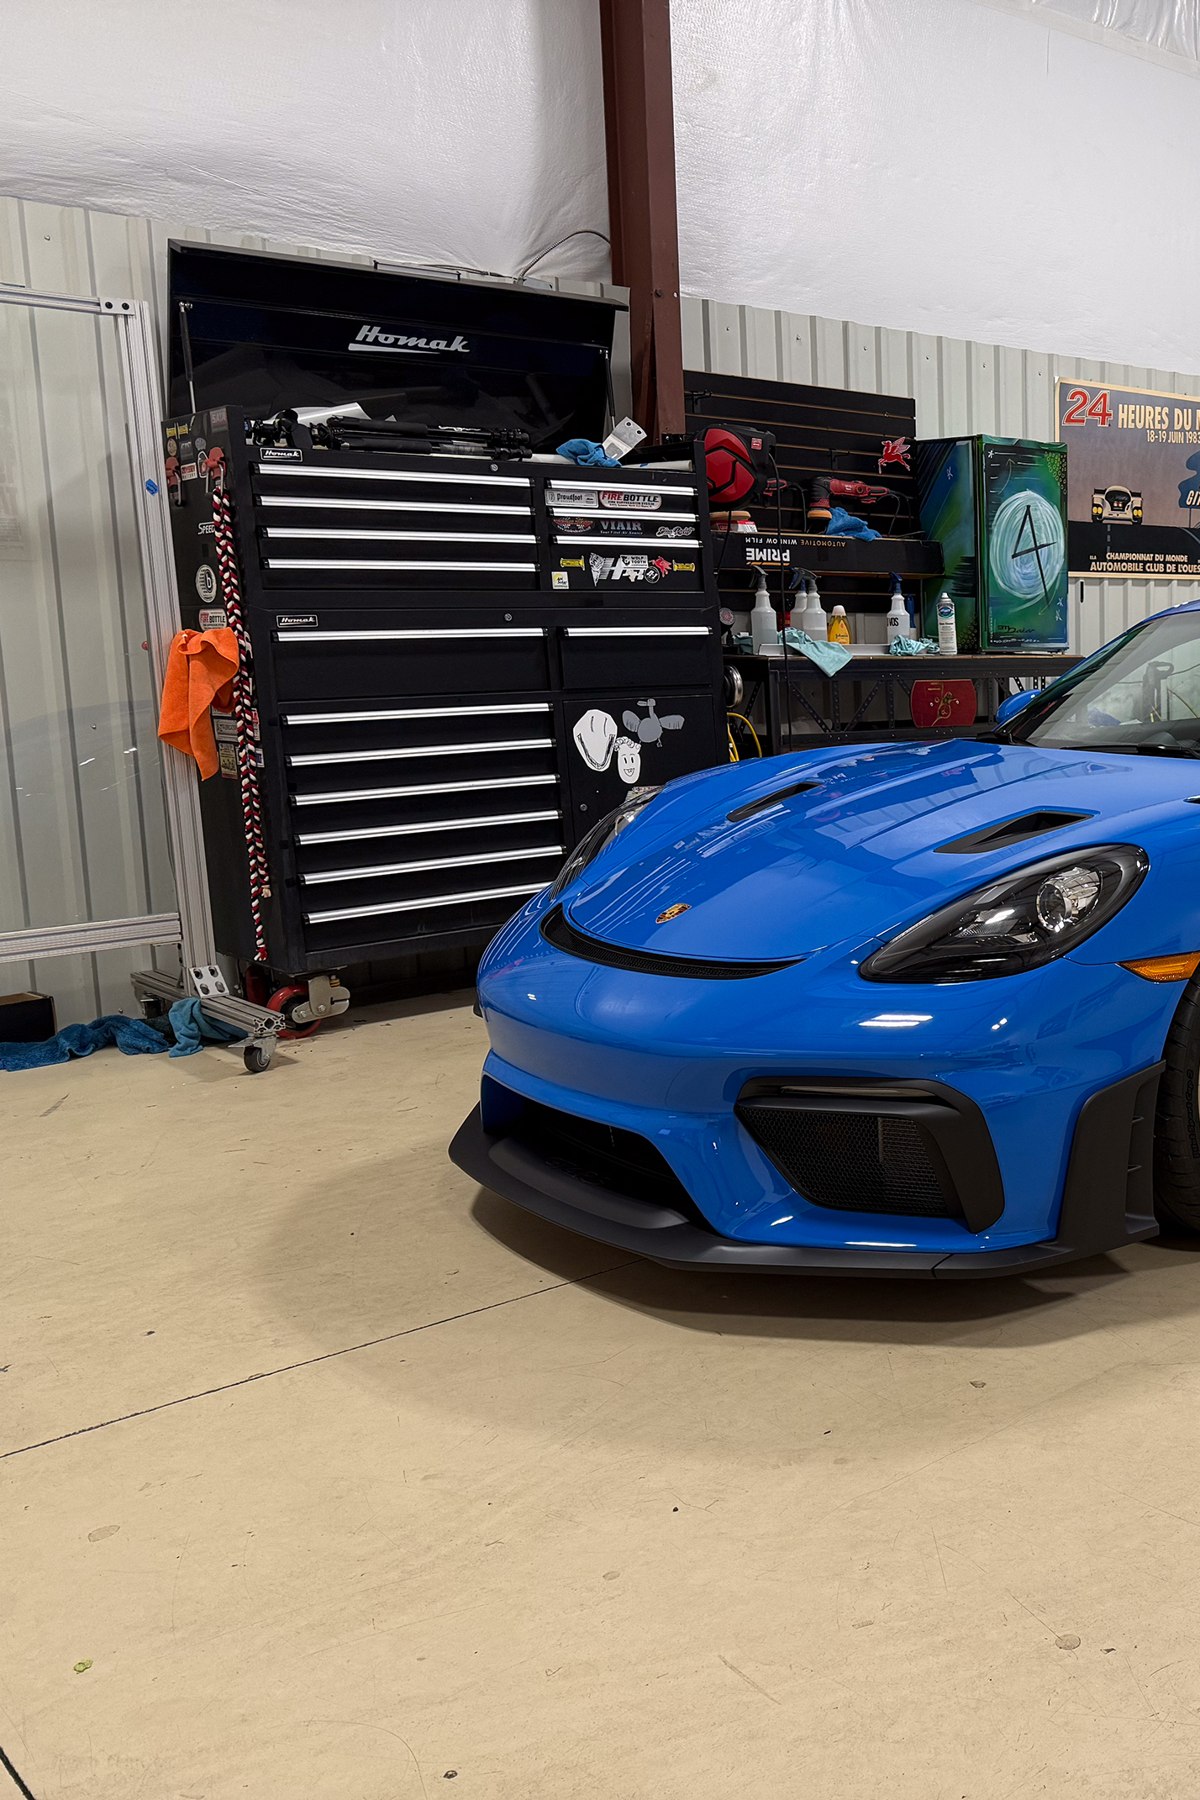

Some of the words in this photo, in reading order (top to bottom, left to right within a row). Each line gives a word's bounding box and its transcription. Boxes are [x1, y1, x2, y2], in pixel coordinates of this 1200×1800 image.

[354, 325, 470, 352] Homak
[1062, 388, 1113, 426] 24
[1118, 404, 1169, 430] HEURES
[1174, 408, 1192, 430] DU
[1146, 429, 1167, 443] 18-19
[1168, 431, 1184, 443] JUIN
[600, 520, 642, 531] VIAIR
[746, 548, 790, 562] PRIME
[1106, 552, 1153, 561] CHAMPIONNAT
[1165, 554, 1188, 563] MONDE
[1090, 562, 1144, 572] AUTOMOBILE
[1145, 563, 1164, 572] CLUB
[1166, 564, 1176, 573] DE
